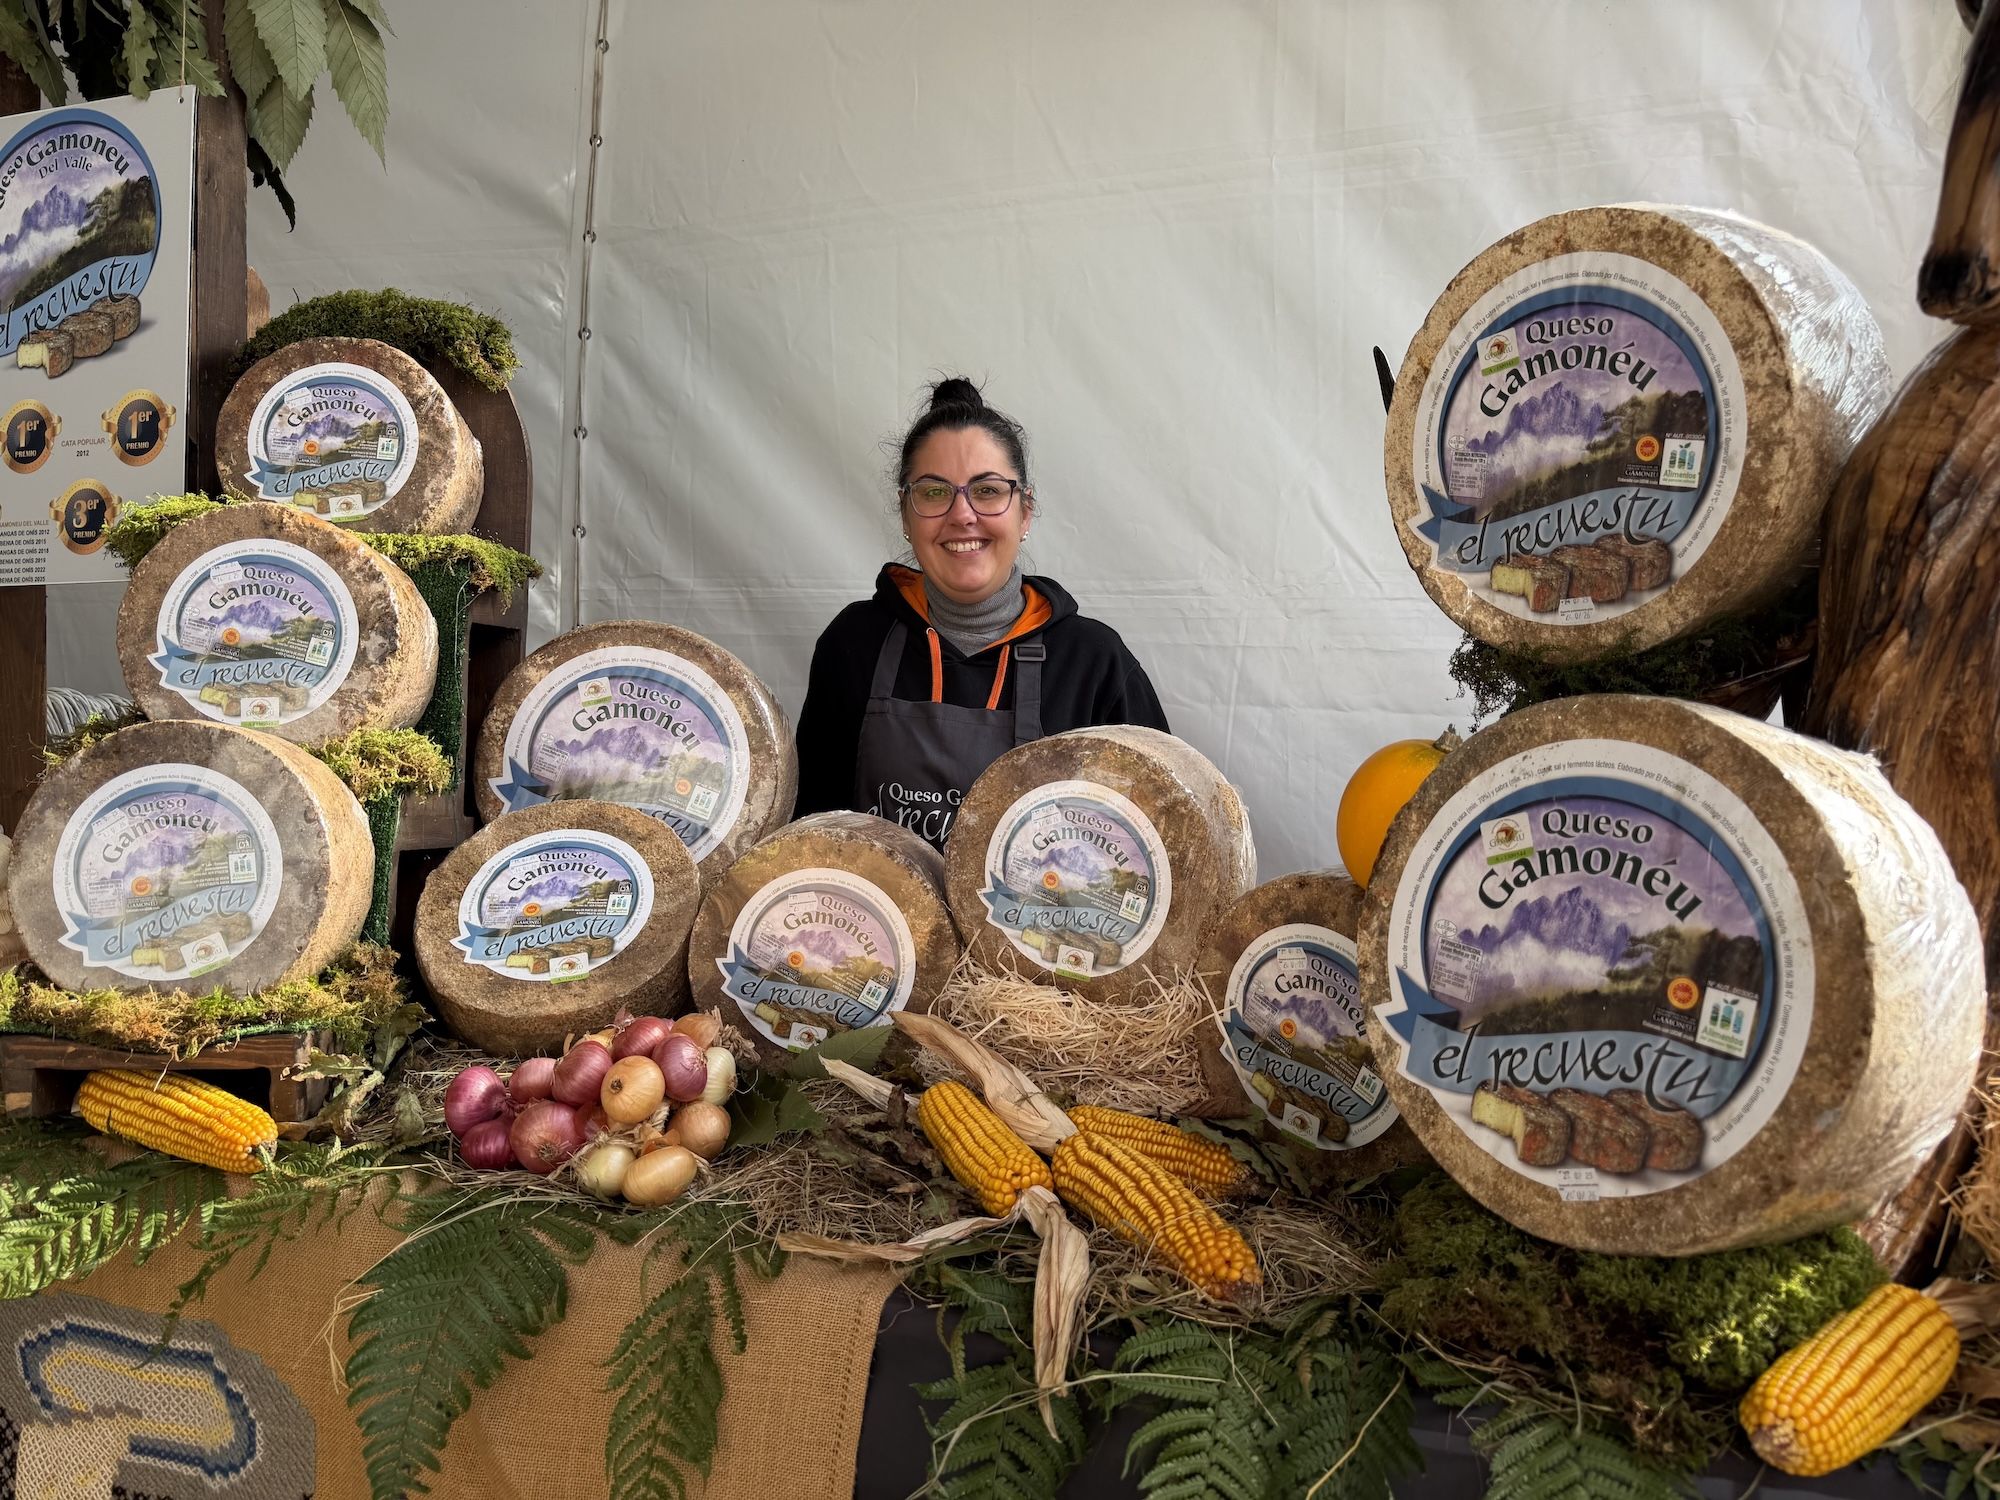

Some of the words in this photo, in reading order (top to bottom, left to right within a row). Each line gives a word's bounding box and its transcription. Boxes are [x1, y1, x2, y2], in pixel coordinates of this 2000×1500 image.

[0, 155, 23, 209] ueso
[26, 133, 130, 176] Gamoneu
[38, 158, 59, 179] Del
[64, 156, 93, 172] Valle
[22, 257, 142, 341] recuestu
[1526, 317, 1614, 345] Queso
[312, 387, 357, 398] Queso
[1479, 341, 1658, 418] Gamonéu
[129, 411, 152, 439] 1er
[287, 399, 377, 428] Gamonéu
[17, 420, 40, 448] 1er
[61, 439, 76, 447] CATA
[77, 437, 105, 446] POPULAR
[126, 441, 149, 450] PREMIO
[15, 450, 37, 458] PREMIO
[274, 464, 296, 494] el
[301, 459, 388, 492] recuestu
[73, 498, 99, 529] 3er
[1456, 512, 1494, 567] el
[1500, 487, 1678, 564] recuestu
[73, 530, 97, 539] PREMIO
[243, 566, 295, 585] Queso
[208, 582, 315, 616] Gamonéu
[179, 658, 206, 686] el
[211, 659, 316, 689] recuestu
[619, 681, 682, 711] Queso
[571, 702, 702, 752] Gamonéu
[127, 798, 187, 818] Queso
[888, 782, 943, 805] Queso
[102, 810, 220, 865] Gamonéu
[1064, 810, 1113, 833] Queso
[1541, 808, 1654, 845] Queso
[538, 852, 588, 863] Queso
[1032, 826, 1130, 867] Gamonéu
[507, 861, 609, 892] Gamonéu
[1478, 843, 1704, 922] Gamonéu
[103, 920, 129, 956] el
[136, 883, 248, 947] recuestu
[821, 896, 867, 923] Queso
[1004, 901, 1028, 925] el
[1032, 909, 1130, 941] recuestu
[484, 932, 510, 957] el
[516, 914, 620, 955] recuestu
[783, 911, 878, 956] Gamonéu
[1310, 958, 1358, 996] Queso
[740, 975, 768, 999] el
[768, 985, 865, 1024] recuestu
[1274, 973, 1368, 1038] Gamonéu
[1237, 1042, 1262, 1067] el
[1263, 1056, 1359, 1117] recuestu
[1433, 1021, 1483, 1084] el
[1488, 1036, 1718, 1113] recuestu
